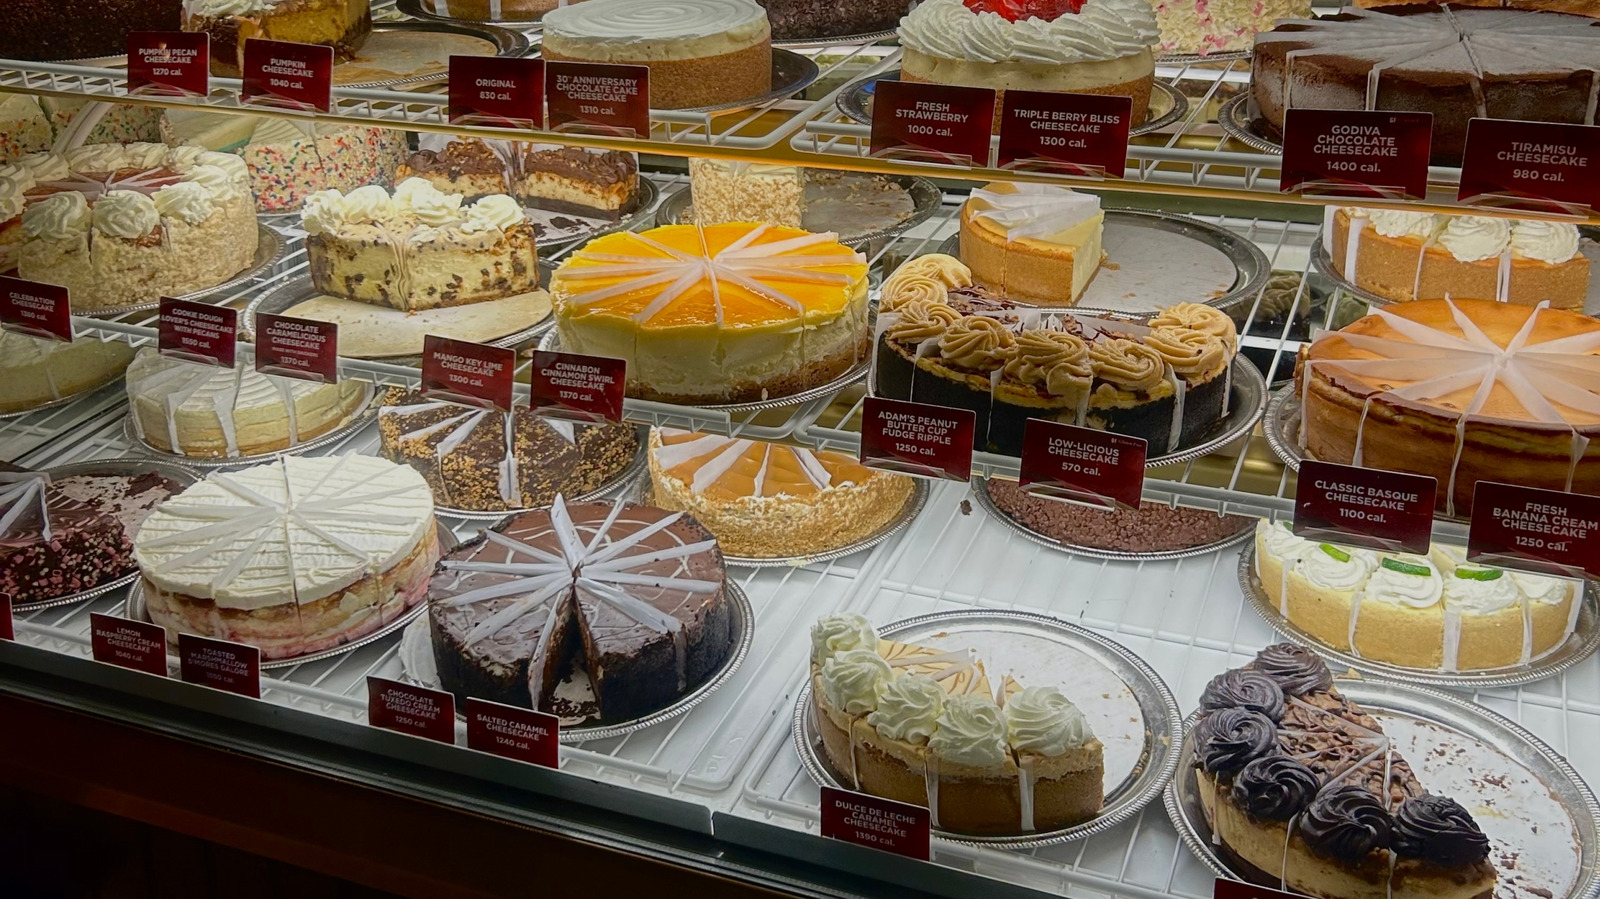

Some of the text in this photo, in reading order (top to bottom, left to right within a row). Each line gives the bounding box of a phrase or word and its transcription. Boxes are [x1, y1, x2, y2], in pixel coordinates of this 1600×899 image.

[270, 58, 306, 68] PUMPKIN
[262, 65, 313, 77] CHEESECAKE
[270, 79, 289, 87] 1040
[476, 79, 516, 88] ORIGINAL
[573, 76, 637, 88] ANNIVERSARY
[556, 84, 638, 95] CHOCOLATE CAKE
[568, 92, 627, 102] CHEESECAKE
[580, 106, 598, 114] 1310
[916, 102, 950, 112] FRESH
[896, 109, 968, 122] STRAWBERRY
[1014, 109, 1120, 124] TRIPLE BERRY BLISS
[908, 125, 952, 136] 1000 cal.
[1030, 121, 1100, 133] CHEESECAKE
[1332, 125, 1380, 135] GODIVA
[1040, 136, 1087, 147] 1300 cal.
[1318, 135, 1395, 146] CHOCOLATE
[1314, 145, 1398, 156] CHEESECAKE
[1512, 142, 1576, 155] TIRAMISU
[1497, 152, 1587, 167] CHEESECAKE
[1327, 162, 1380, 172] 1400 cal.
[1513, 169, 1564, 181] 980 cal.
[10, 292, 55, 305] CELEBRATION
[12, 299, 54, 312] CHEESECAKE
[172, 308, 223, 323] COOKIE DOUGH
[161, 315, 233, 333] LOVER'S CHEESECAKE
[274, 321, 319, 333] CHOCOLATE
[174, 325, 219, 339] WITH PECANS
[267, 328, 326, 342] CARAMELICIOUS
[272, 337, 320, 349] CHEESECAKE
[281, 356, 309, 367] 1370 cal.
[434, 352, 503, 370] MANGO KEY LIME
[441, 361, 494, 376] CHEESECAKE
[556, 363, 600, 374] CINNABON
[449, 374, 468, 383] 1300
[541, 369, 615, 384] CINNAMON SWIRL
[550, 378, 604, 390] CHEESECAKE
[560, 391, 578, 399] 1370
[878, 411, 957, 429] ADAM'S PEANUT
[888, 421, 947, 435] BUTTER CUP
[882, 428, 951, 445] FUDGE RIPPLE
[895, 443, 935, 456] 1250 cal.
[1049, 438, 1119, 456] LOW-LICIOUS
[1048, 446, 1118, 465] CHEESECAKE
[1062, 462, 1100, 476] 570 cal.
[1315, 480, 1418, 502] CLASSIC BASQUE
[1325, 492, 1404, 511] CHEESECAKE
[1340, 508, 1386, 523] 1100 cal.
[1526, 502, 1567, 516] FRESH
[1493, 508, 1598, 530] BANANA CREAM
[1502, 520, 1587, 538] CHEESECAKE
[1516, 536, 1568, 551] 1250 cal.
[117, 627, 140, 639] LEMON
[96, 630, 160, 651] RASPBERRY CREAM
[108, 639, 150, 654] CHEESECAKE
[116, 650, 131, 660] 1040
[191, 652, 247, 669] MARSHMALLOW
[203, 648, 235, 659] TOASTED
[188, 658, 248, 676] S'MORES GALORE
[381, 694, 440, 714] TUXEDO CREAM
[388, 689, 433, 705] CHOCOLATE
[386, 703, 436, 719] CHEESECAKE
[396, 716, 412, 725] 1250
[477, 714, 548, 736] SALTED CARAMEL
[486, 723, 539, 740] CHEESECAKE
[496, 736, 530, 750] 1240 cal.
[836, 800, 915, 824] DULCE DE LECHE
[844, 817, 906, 837] CHEESECAKE
[852, 812, 898, 828] CARAMEL
[856, 831, 895, 846] 1390 cal.
